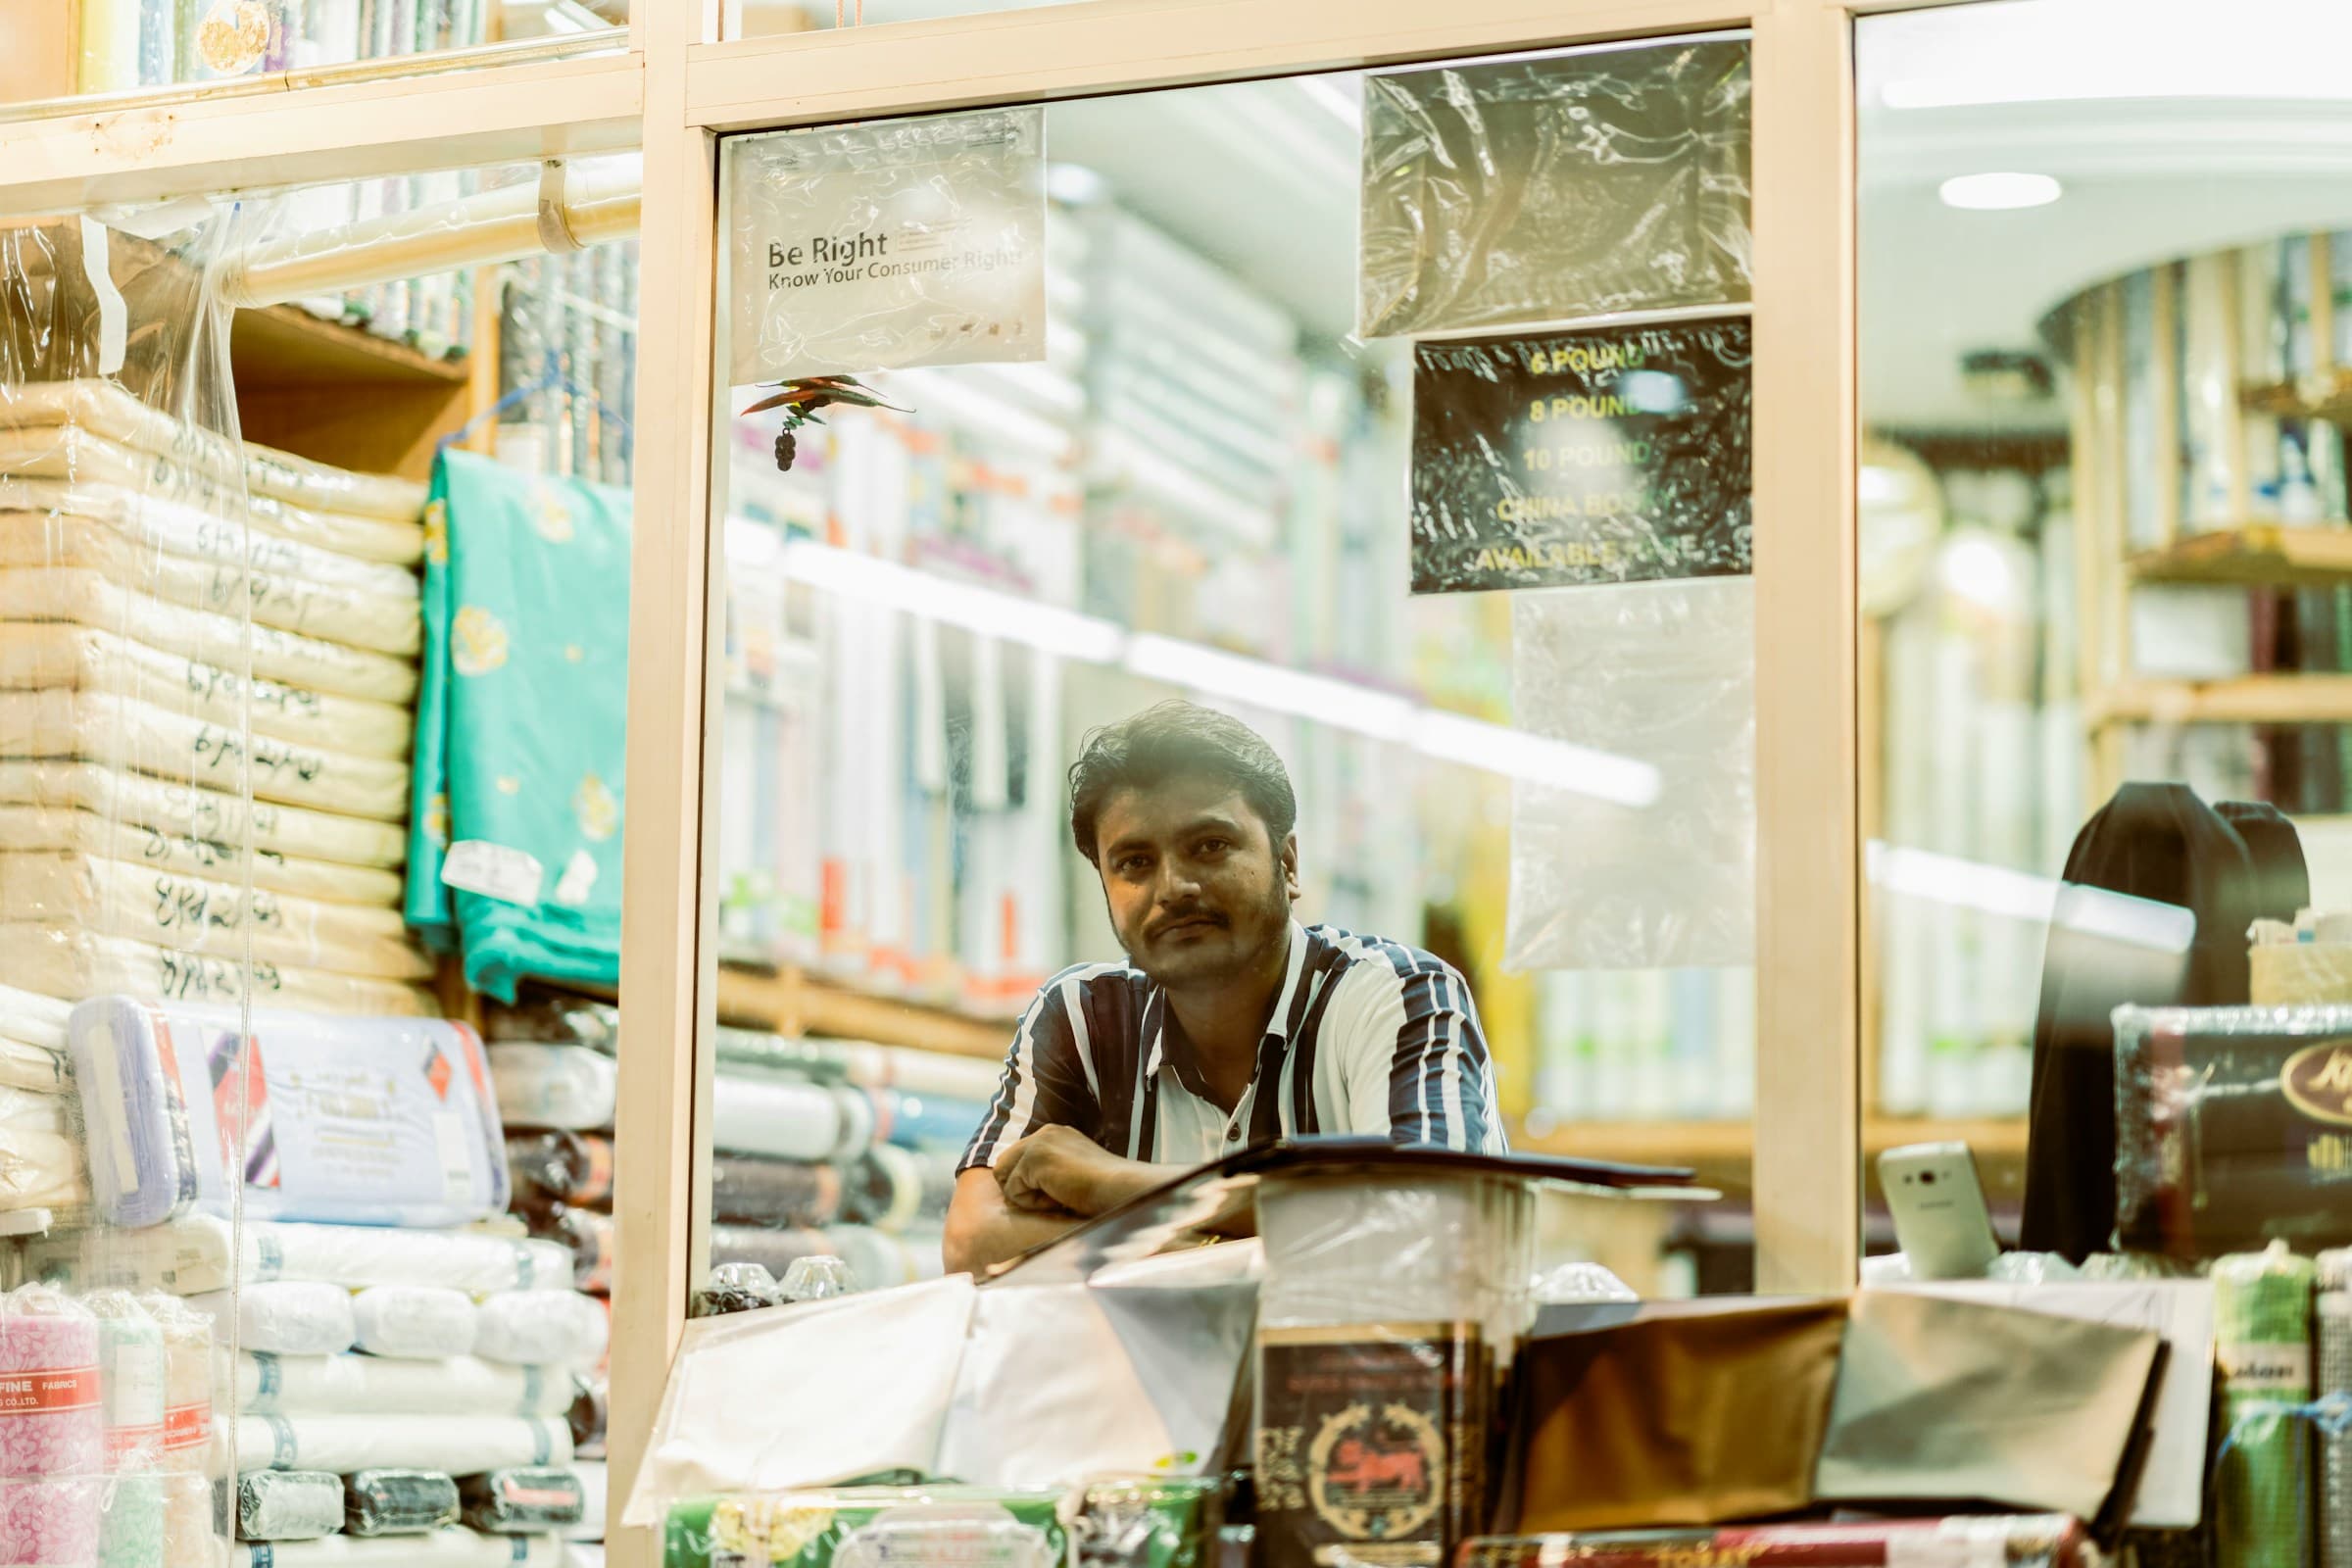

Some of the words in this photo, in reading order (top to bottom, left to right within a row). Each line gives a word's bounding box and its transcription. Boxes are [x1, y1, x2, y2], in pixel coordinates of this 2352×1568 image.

[768, 242, 803, 268] Be
[812, 232, 888, 267] Right
[768, 272, 819, 290] Know
[824, 267, 863, 285] Your
[868, 254, 959, 279] Consumer
[1552, 344, 1645, 372] POUND
[1530, 400, 1545, 422] 8
[1524, 448, 1551, 470] 10
[1559, 441, 1650, 468] POUND
